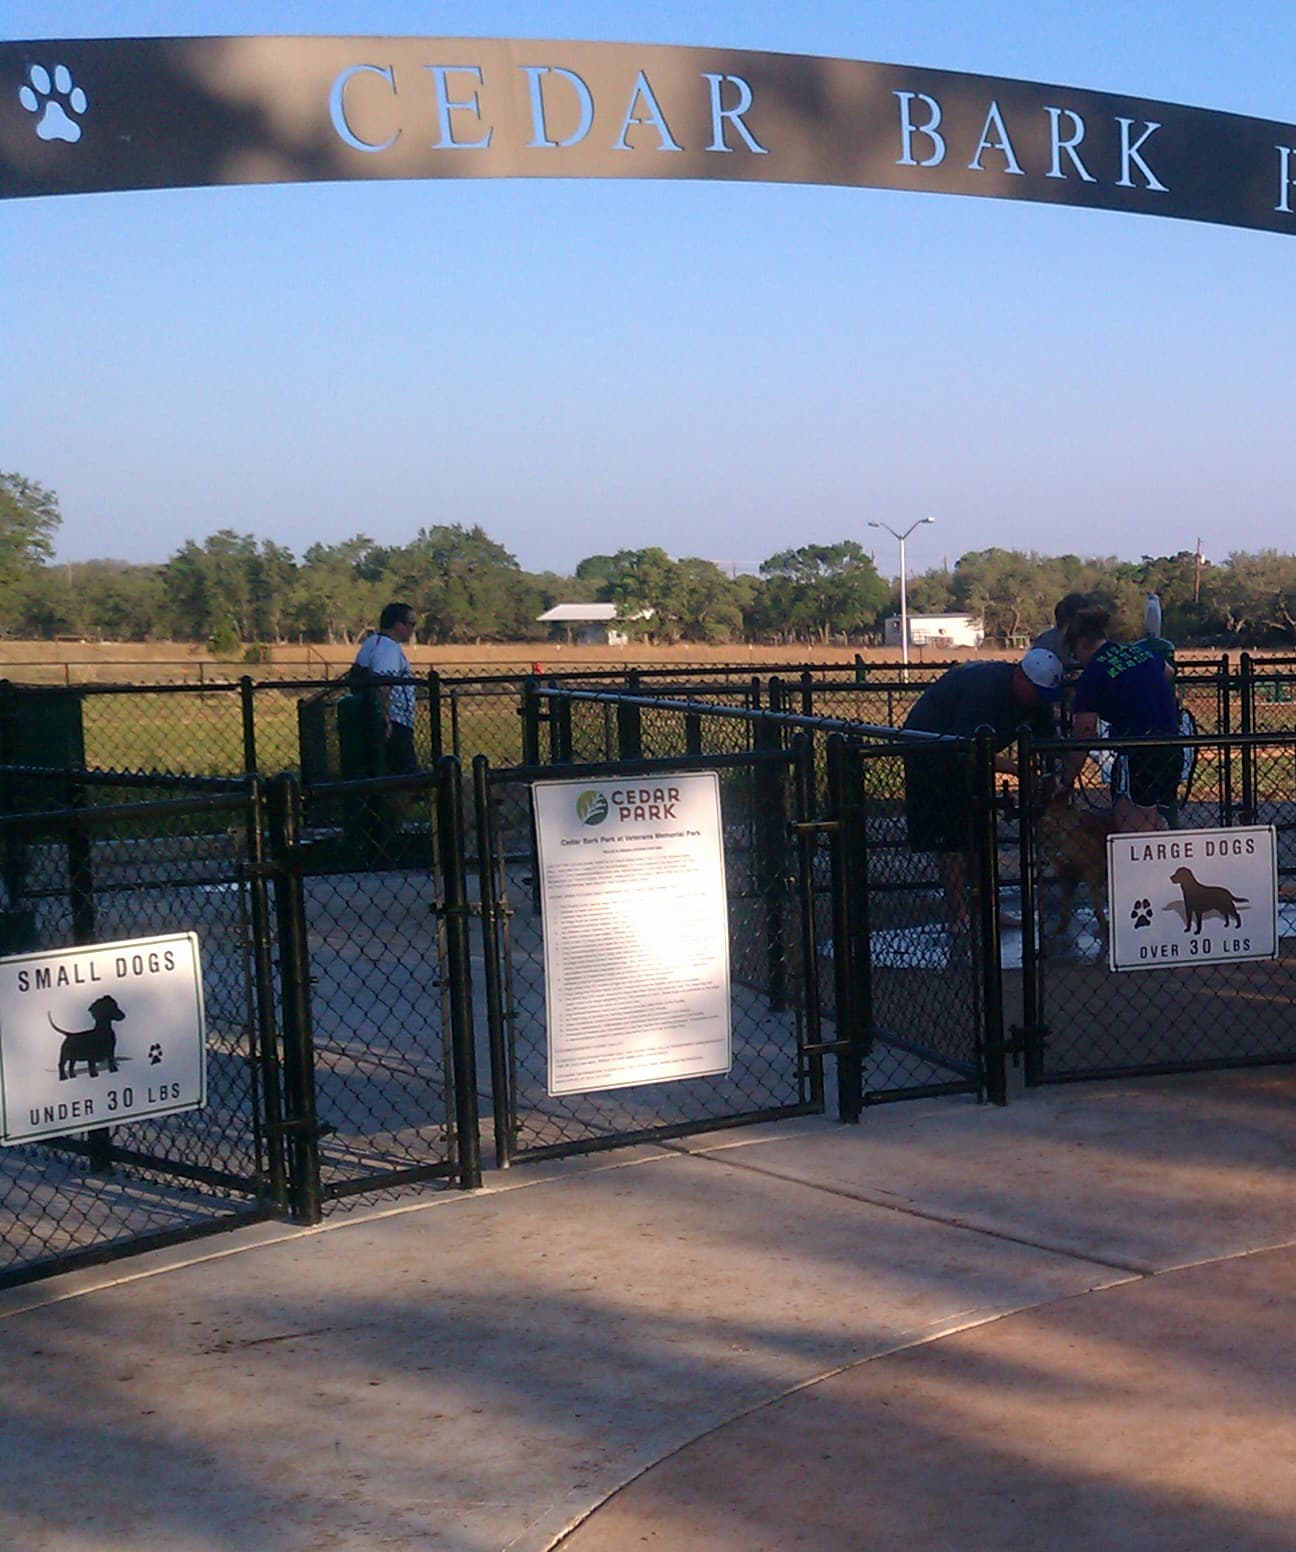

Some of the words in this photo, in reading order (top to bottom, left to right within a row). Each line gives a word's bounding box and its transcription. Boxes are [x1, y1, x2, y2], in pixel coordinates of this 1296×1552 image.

[329, 64, 769, 155] CEDAR
[892, 89, 1170, 193] BARK
[611, 787, 681, 805] CEDAR
[619, 804, 677, 822] PARK
[560, 838, 581, 846] Cedar
[583, 836, 599, 845] Bark
[600, 835, 616, 843] Park
[625, 832, 654, 841] Veterans
[655, 830, 684, 839] Memorial
[686, 829, 701, 838] Park
[1130, 842, 1194, 861] LARGE
[1205, 838, 1255, 857] DOGS
[1139, 944, 1179, 959] OVER
[1190, 938, 1212, 955] 30
[1223, 938, 1251, 953] LBS
[17, 961, 102, 992] SMALL
[115, 950, 176, 979] DOGS
[29, 1098, 94, 1126] UNDER
[107, 1087, 134, 1112] 30
[147, 1082, 181, 1104] LBS
